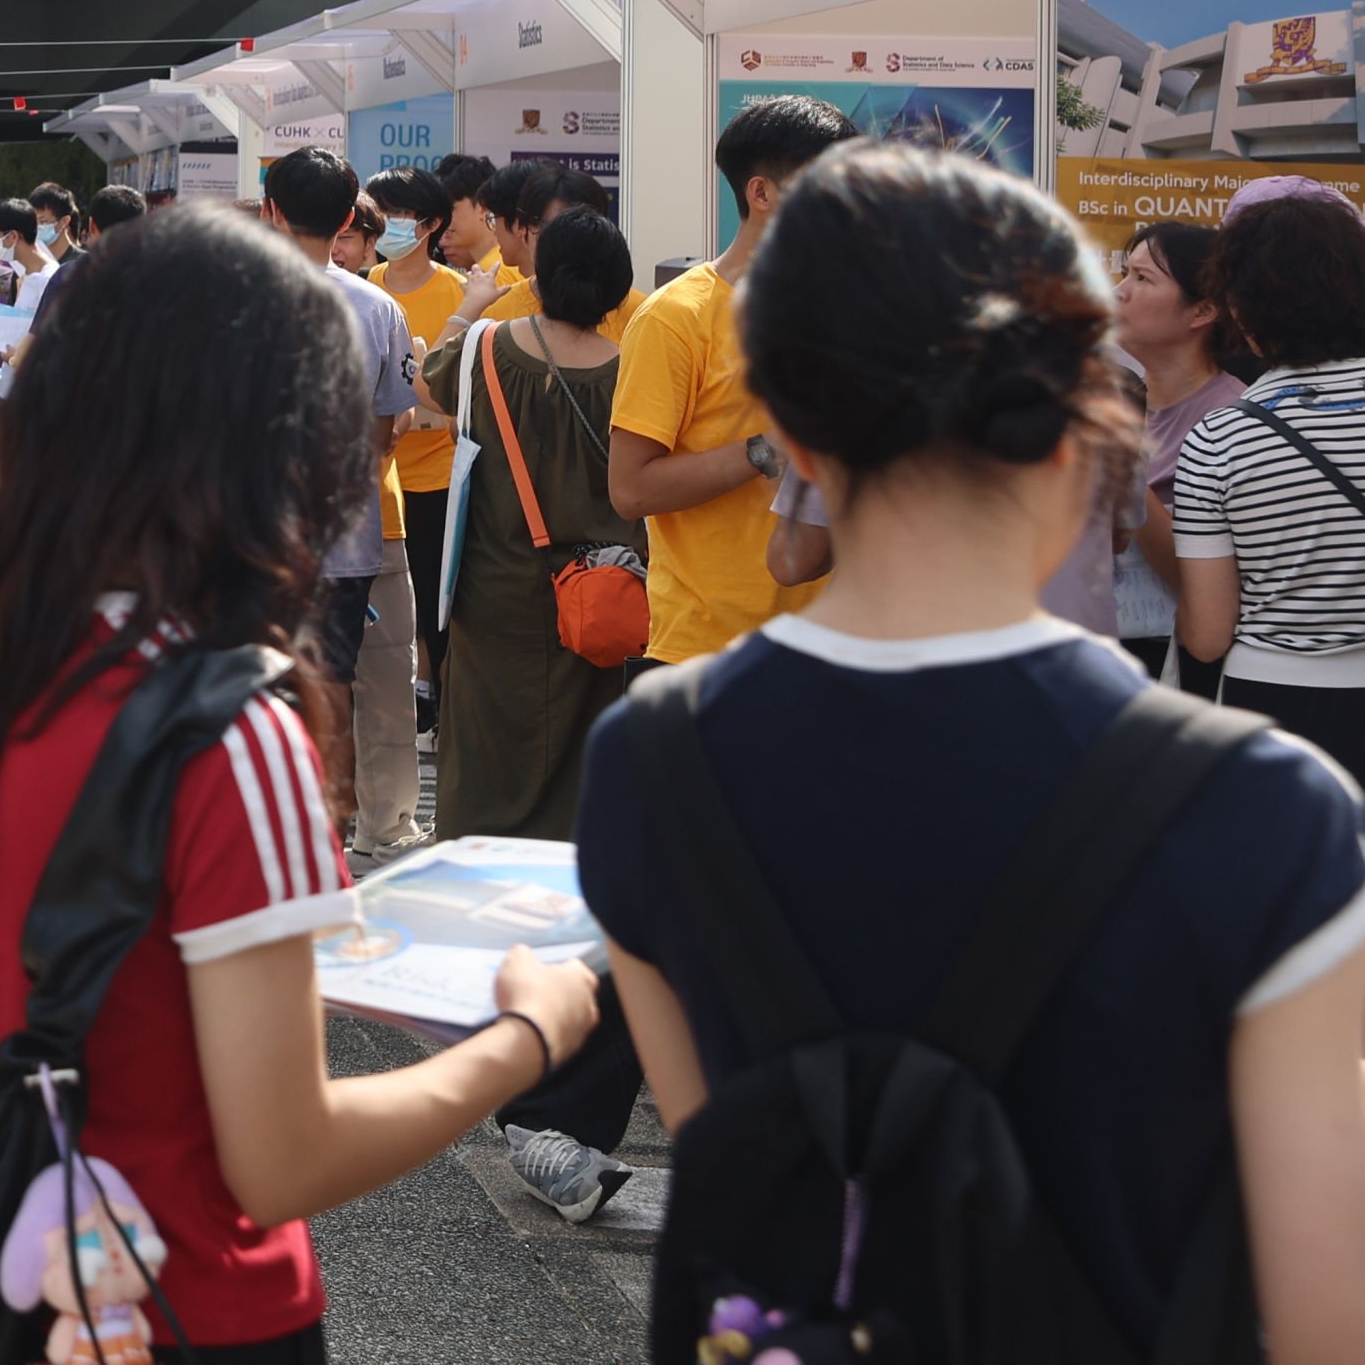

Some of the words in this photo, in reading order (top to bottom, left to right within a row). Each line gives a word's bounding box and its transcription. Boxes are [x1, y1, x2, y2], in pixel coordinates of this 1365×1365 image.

[518, 19, 543, 50] Statistics
[1005, 62, 1034, 71] CDAS
[274, 125, 311, 138] CUHK
[328, 127, 344, 139] CU
[380, 123, 431, 148] OUR
[569, 160, 579, 171] is
[583, 159, 620, 172] Statis
[1078, 171, 1209, 192] Interdisciplinary
[1214, 174, 1253, 190] Majo
[1078, 201, 1109, 215] BSc
[1113, 201, 1128, 215] in
[1134, 196, 1229, 218] QUANT
